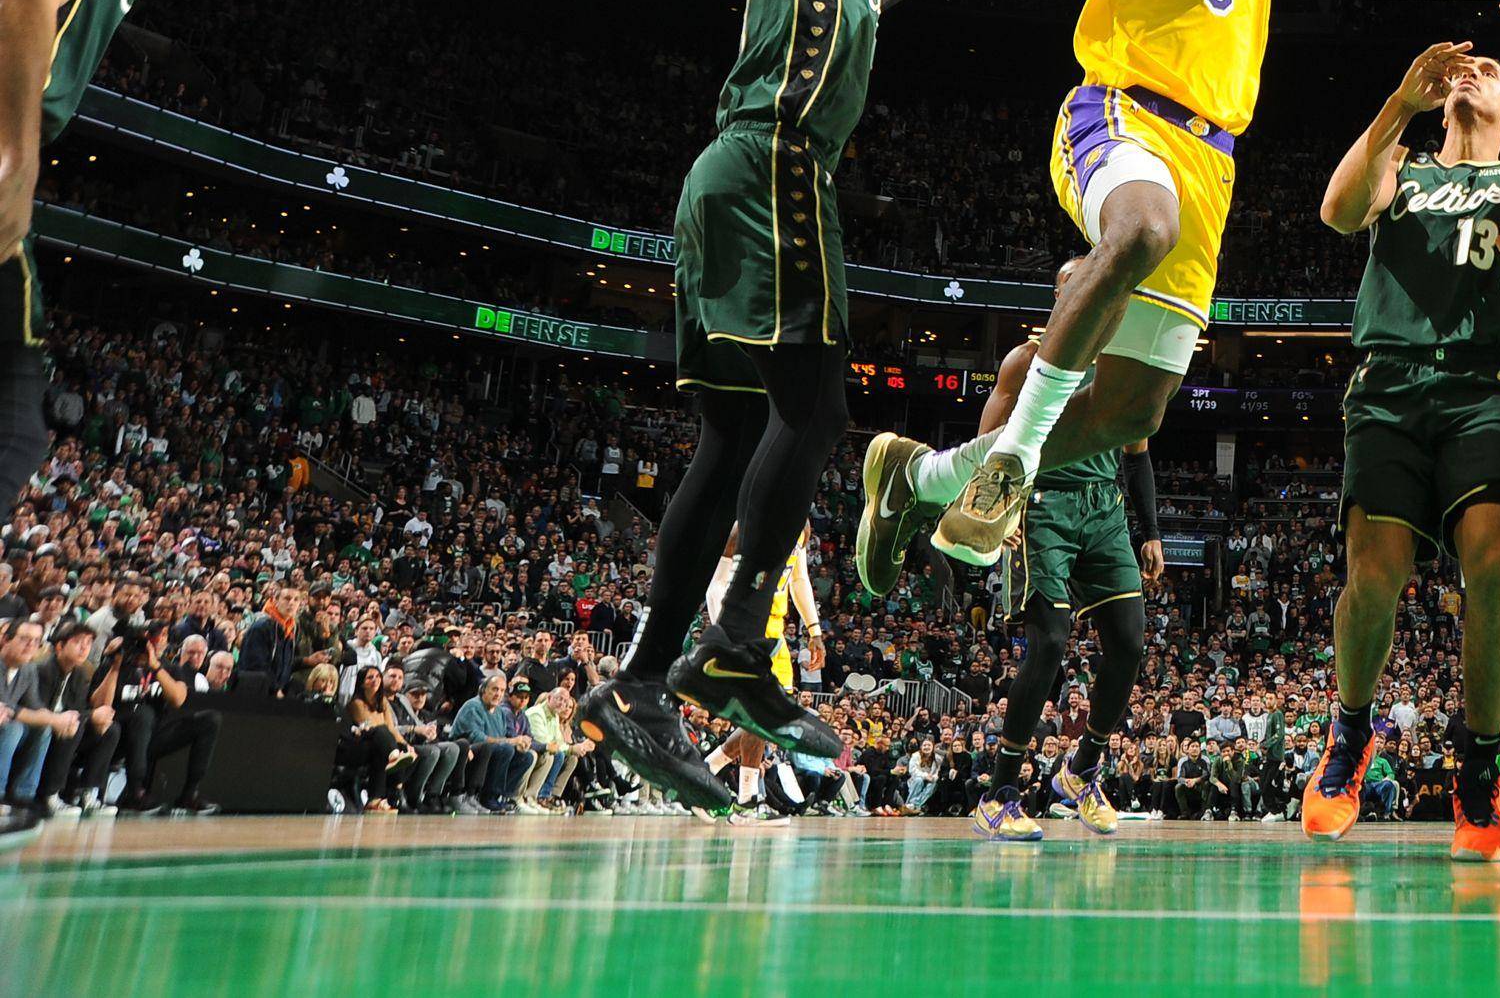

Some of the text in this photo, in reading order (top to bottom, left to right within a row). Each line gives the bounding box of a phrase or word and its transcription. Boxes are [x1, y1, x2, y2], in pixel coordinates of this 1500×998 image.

[1456, 218, 1499, 271] 13
[475, 306, 590, 346] DEFENSE
[934, 374, 958, 390] 16
[971, 373, 995, 382] 50/50
[1192, 389, 1210, 398] 3PT
[1291, 392, 1314, 400] FG%
[1190, 400, 1217, 411] 11/39
[1240, 402, 1268, 410] 41/95
[1295, 402, 1308, 410] 43
